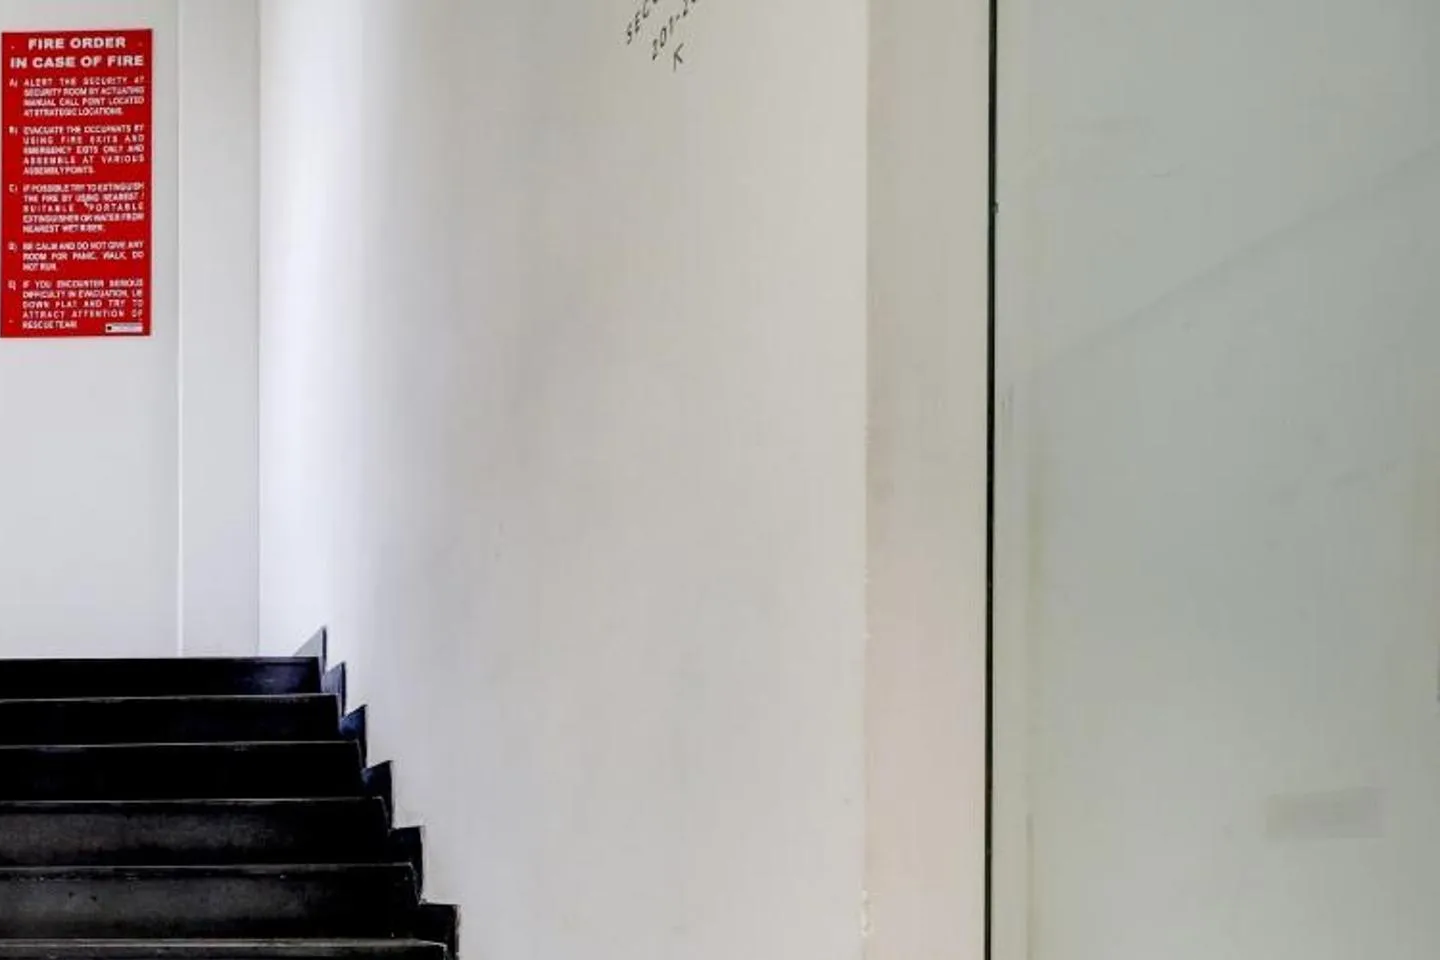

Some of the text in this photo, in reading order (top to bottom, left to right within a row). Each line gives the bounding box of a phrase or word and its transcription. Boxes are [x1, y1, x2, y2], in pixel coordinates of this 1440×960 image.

[28, 38, 126, 50] FIRE ORDER
[9, 55, 144, 69] IN CASE OF FIRE
[24, 78, 53, 87] ALERT
[60, 77, 77, 86] THE
[83, 76, 127, 86] SECURITY
[24, 86, 145, 97] SECURITY ROOM BY ACTUATING
[23, 96, 145, 107] MANUAL CALL POINT LOCATED
[23, 126, 64, 135] EVACUATE
[66, 126, 81, 134] THE
[84, 125, 131, 134] OCCUPANTS
[23, 135, 145, 145] USING FIRE EXITS AND
[23, 145, 145, 155] EMERGENCY EXITS ONLY AND
[23, 155, 145, 165] ASSEMBLE AT VARIOUS
[23, 195, 39, 203] THE
[42, 194, 59, 203] FIRE
[61, 194, 73, 202] BY
[76, 194, 100, 202] USING
[103, 193, 139, 202] NEAREST
[23, 203, 145, 213] SUITABLE PORTABLE
[23, 225, 61, 233] NEAREST
[23, 243, 33, 251] BE
[59, 242, 76, 250] AND
[76, 242, 89, 250] DO
[90, 242, 107, 250] NOT
[23, 253, 47, 261] ROOM
[51, 252, 68, 261] FOR
[132, 252, 144, 260] DO
[23, 263, 40, 271] NOT
[23, 280, 31, 289] IF
[35, 280, 52, 288] YOU
[57, 280, 104, 288] ENCOUNTER
[109, 279, 144, 287] SERIOUS
[23, 290, 66, 299] DIFFICULTY
[67, 290, 76, 298] IN
[23, 301, 51, 309] DOWN
[83, 300, 103, 308] AND
[108, 300, 125, 308] TRY
[131, 300, 144, 308] TO
[23, 310, 142, 319] ATTRACT ATTENTION OF
